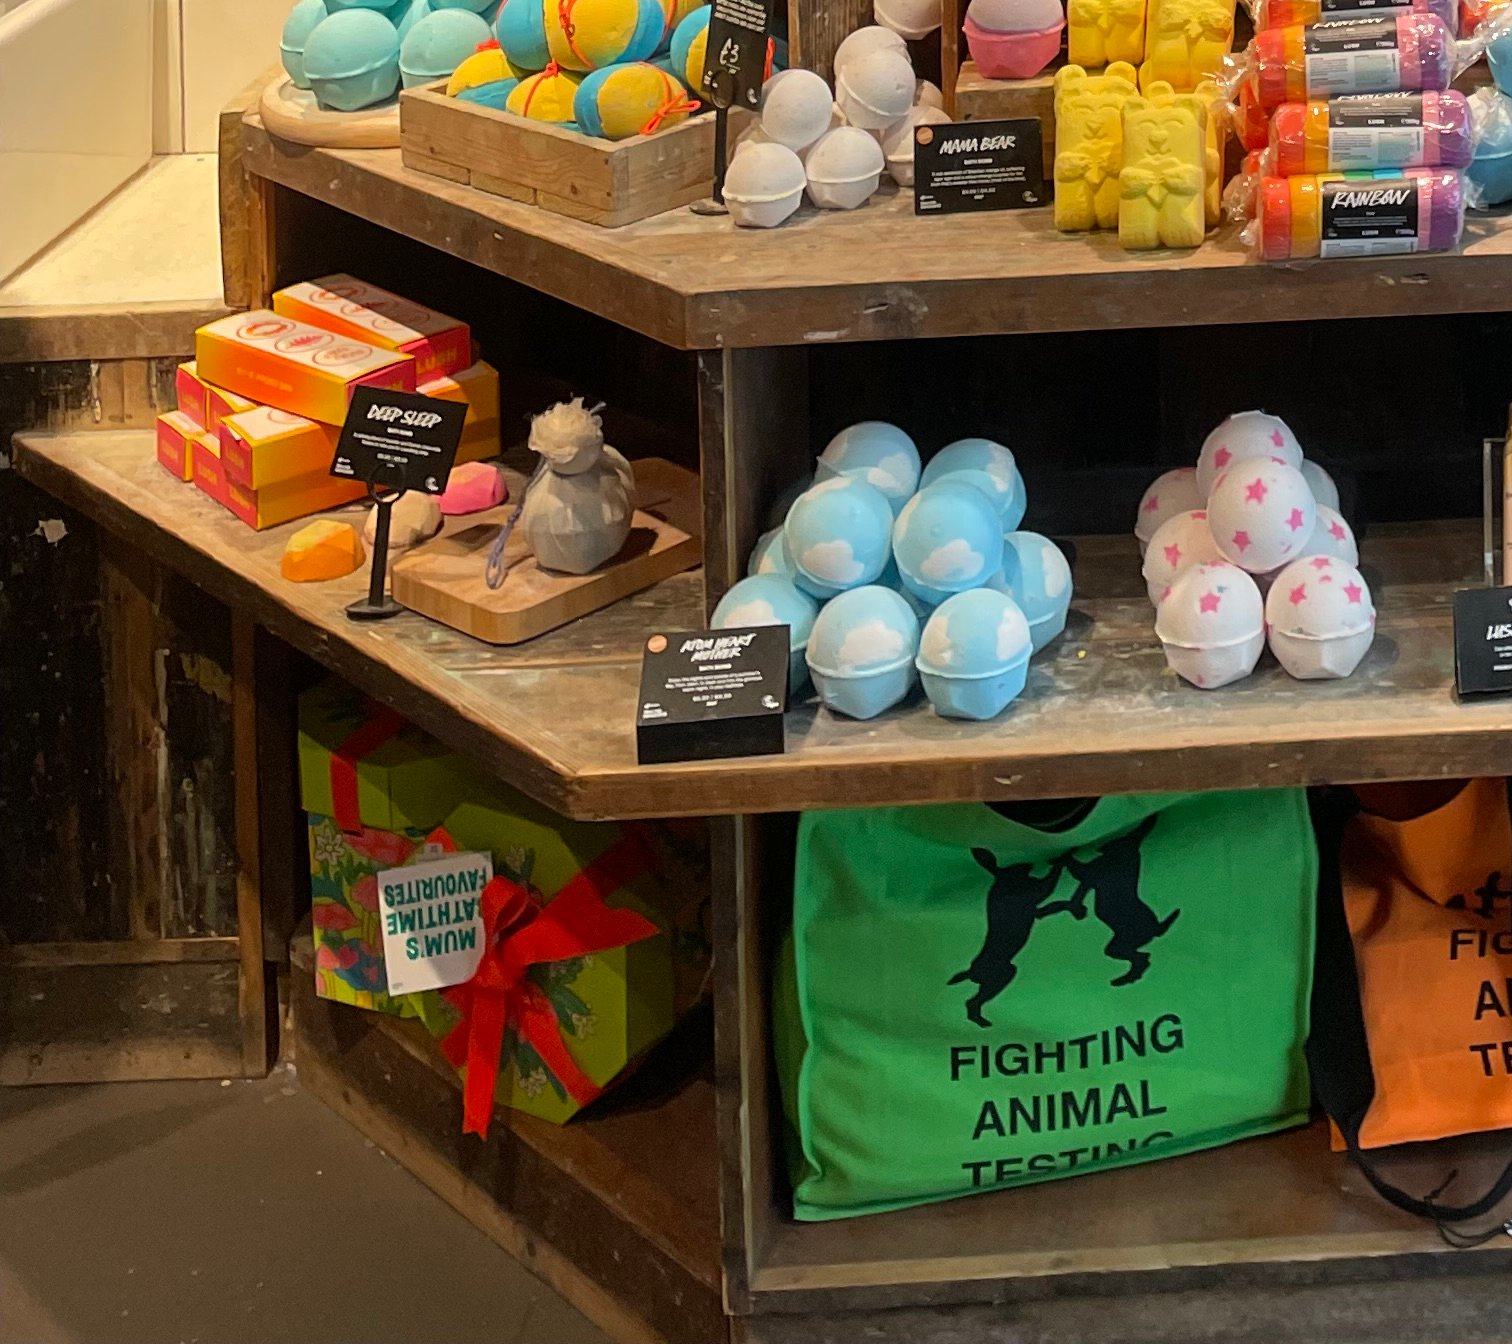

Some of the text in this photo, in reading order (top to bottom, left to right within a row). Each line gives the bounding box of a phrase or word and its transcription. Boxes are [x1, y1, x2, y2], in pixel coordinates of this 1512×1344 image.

[939, 135, 1017, 155] MAMA BEAR
[1331, 188, 1411, 210] RAINBOW
[367, 404, 443, 429] DEEP SLEEP
[386, 896, 482, 935] ATHTIME
[406, 926, 476, 961] MUM'S
[950, 1013, 1185, 1082] FIGHTING
[972, 1079, 1168, 1141] ANIMAL
